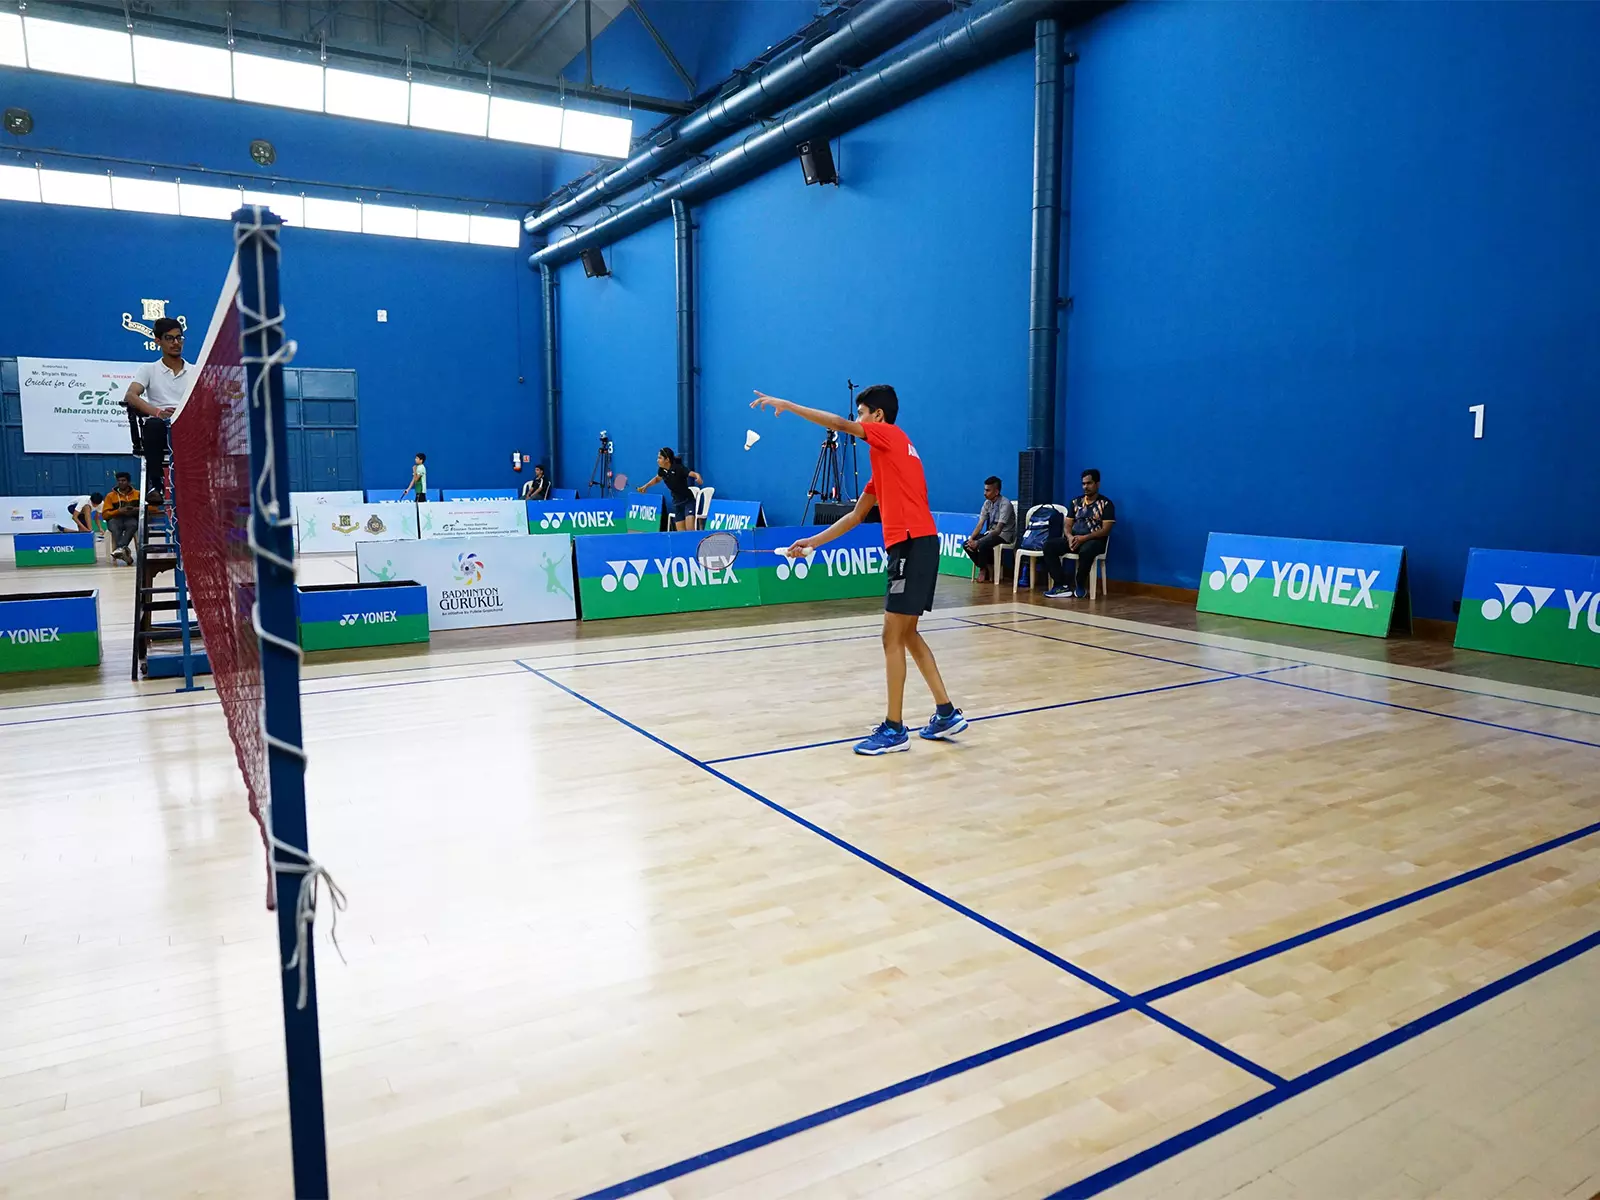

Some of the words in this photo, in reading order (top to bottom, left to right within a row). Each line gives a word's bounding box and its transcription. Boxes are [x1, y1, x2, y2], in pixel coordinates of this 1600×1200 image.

[24, 378, 52, 387] Cricket
[54, 380, 65, 389] for
[68, 379, 86, 388] Care
[54, 407, 109, 415] Maharashtra
[111, 408, 127, 416] Ope
[1468, 404, 1485, 439] 1
[568, 510, 615, 528] YONEX
[639, 505, 658, 522] YONEX
[725, 513, 751, 530] YONEX
[52, 545, 75, 553] YONEX
[821, 546, 889, 577] YONEX
[654, 554, 738, 588] YONEX
[442, 587, 499, 599] BADMINTON
[1271, 560, 1380, 609] YONEX
[439, 596, 504, 610] GURUKUL
[362, 610, 398, 624] YONEX
[8, 627, 60, 645] YONEX
